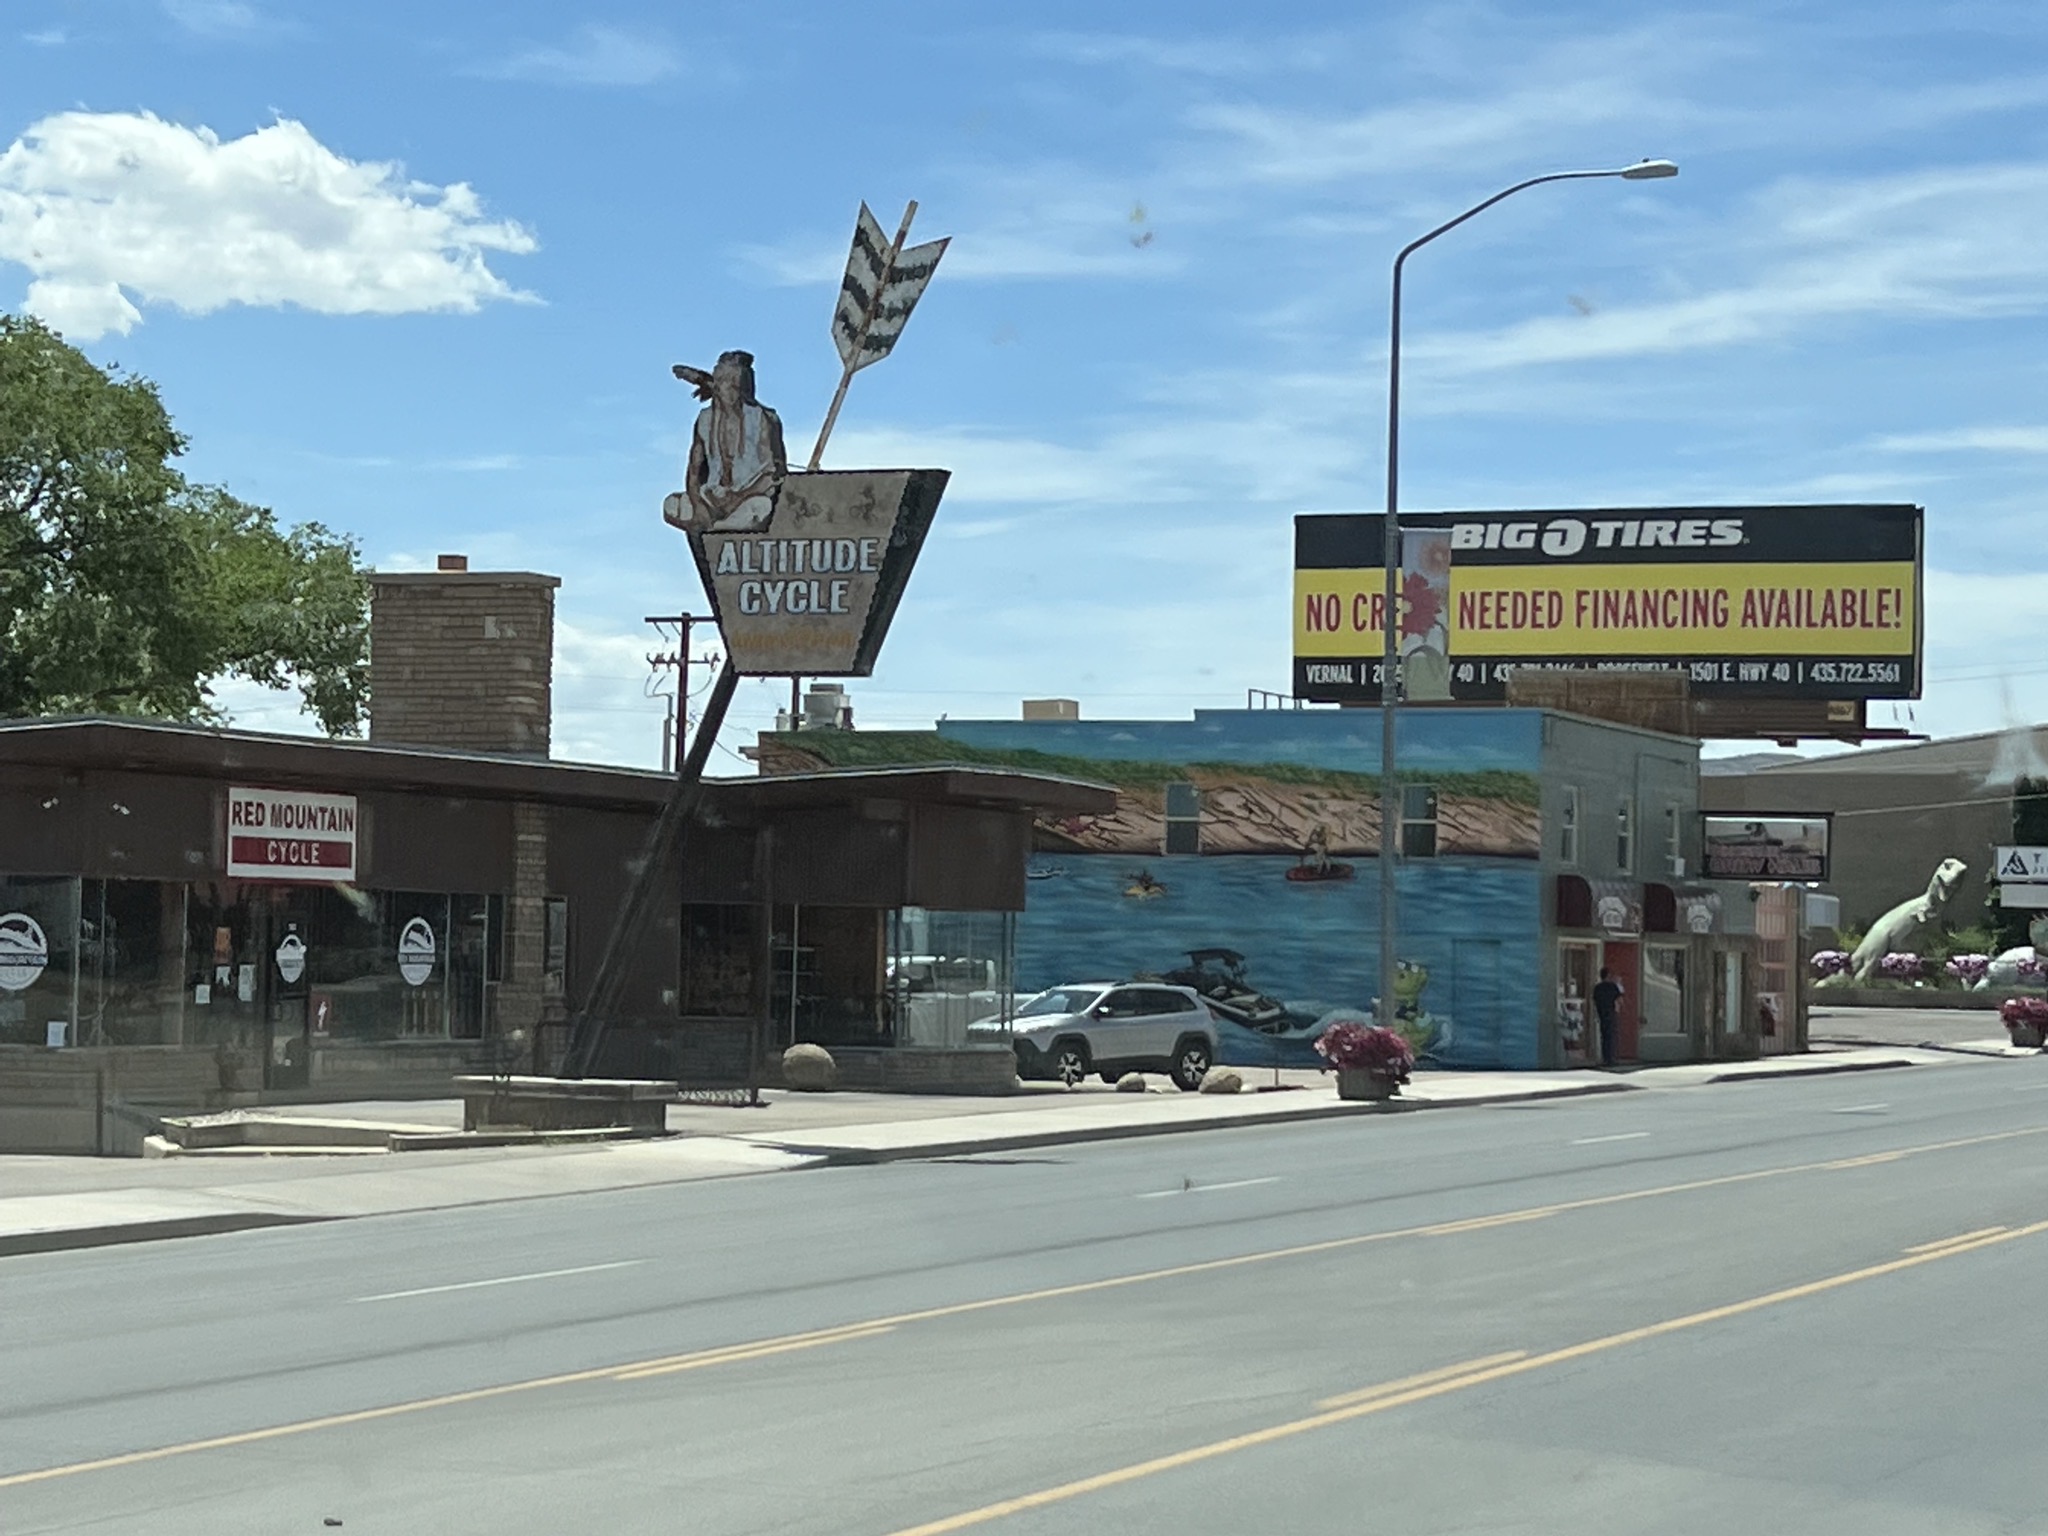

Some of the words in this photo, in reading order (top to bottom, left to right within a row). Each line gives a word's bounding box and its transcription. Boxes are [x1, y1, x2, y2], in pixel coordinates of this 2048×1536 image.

[1451, 522, 1539, 550] BIG
[1590, 518, 1744, 548] TIRES
[716, 537, 879, 575] ALTITUDE
[738, 579, 850, 615] CYCLE
[1306, 592, 1341, 632] NO
[1459, 590, 1563, 630] NEEDED
[1575, 588, 1729, 630] FINANCING
[1741, 587, 1902, 629] AVAILABLE!
[1306, 664, 1353, 684] VERNAL
[1456, 663, 1474, 683] 40
[1739, 662, 1769, 681] HWY
[1772, 662, 1790, 681] 40
[232, 800, 265, 827] RED
[270, 803, 354, 833] MOUNTAIN
[267, 840, 321, 865] CYCLE
